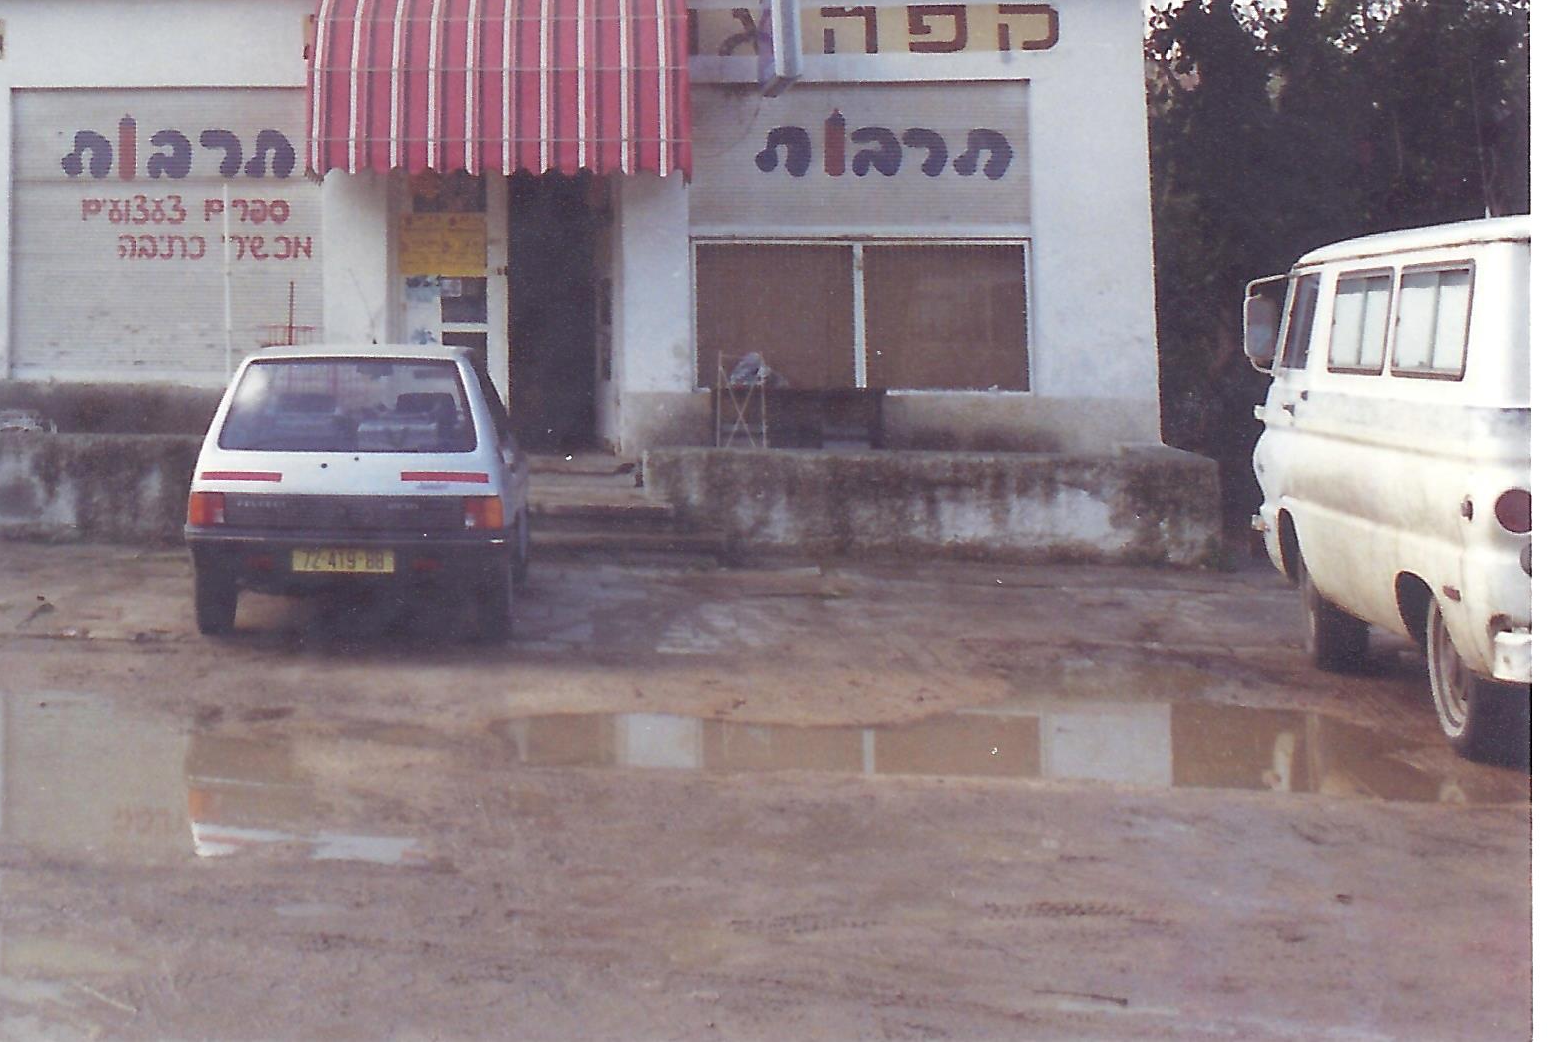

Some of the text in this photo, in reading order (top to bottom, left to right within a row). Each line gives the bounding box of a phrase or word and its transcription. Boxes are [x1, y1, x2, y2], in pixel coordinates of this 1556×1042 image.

[820, 3, 1060, 54] קפה
[61, 113, 296, 182] תרבות
[754, 108, 1014, 180] תרבות
[81, 194, 291, 225] ספרם צעצועים
[117, 234, 206, 260] כתיבה
